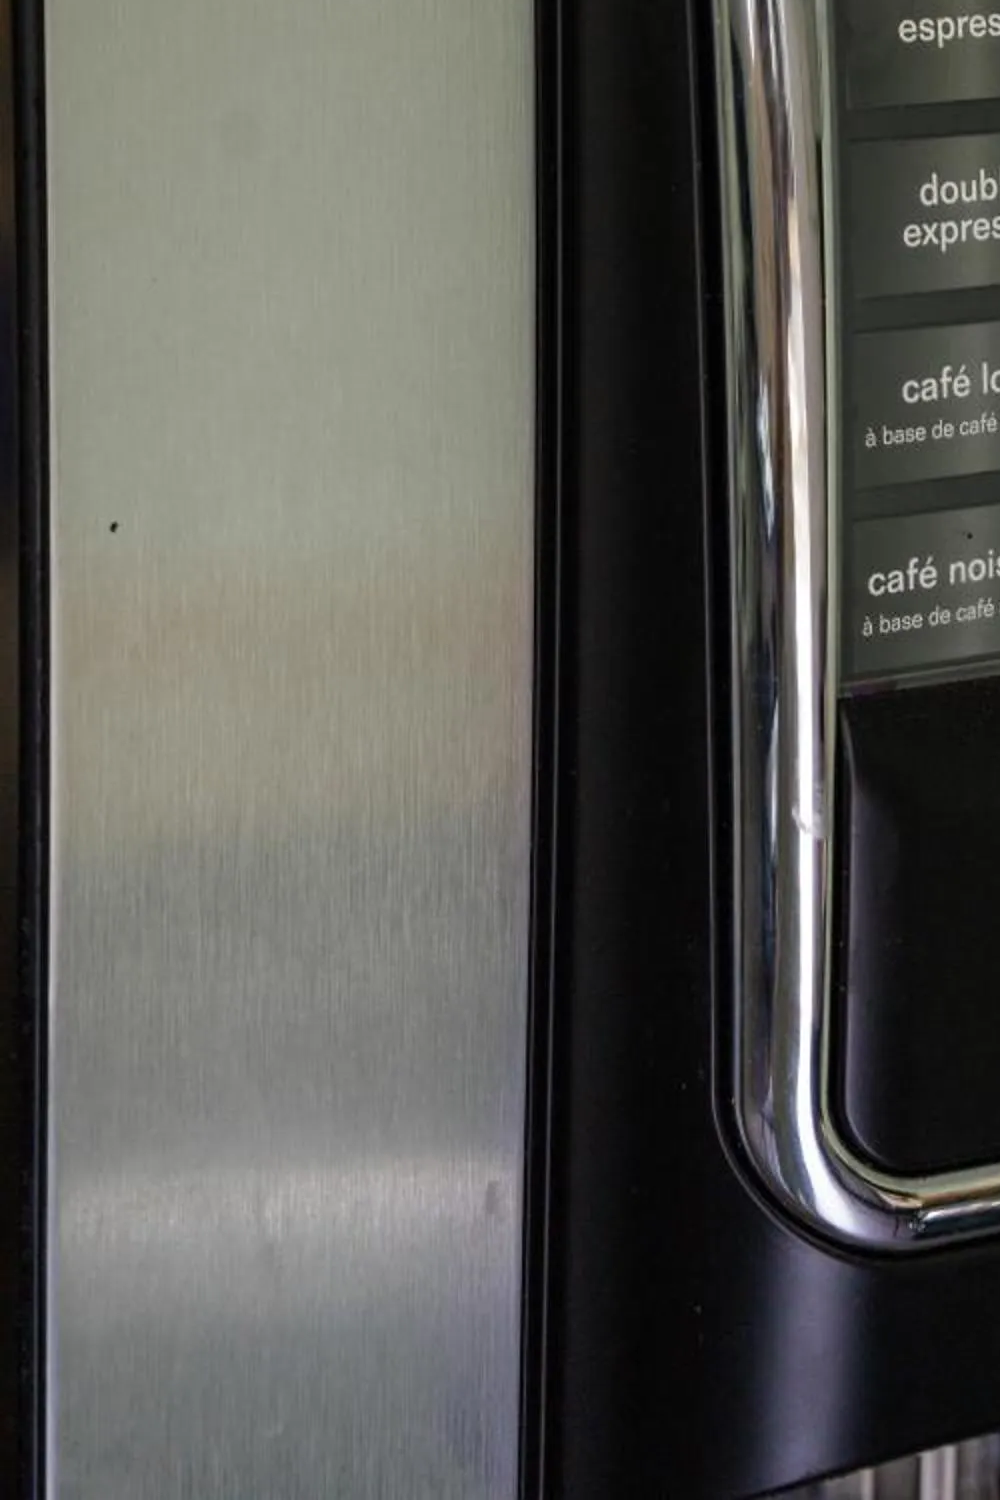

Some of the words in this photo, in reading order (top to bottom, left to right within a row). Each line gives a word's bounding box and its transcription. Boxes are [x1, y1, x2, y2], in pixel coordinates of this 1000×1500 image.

[902, 365, 971, 403] café
[865, 428, 877, 448] à
[882, 425, 926, 445] base
[931, 419, 955, 440] de
[959, 413, 998, 436] café
[867, 556, 938, 597] café
[862, 615, 874, 638] à
[879, 613, 923, 634] base
[928, 607, 952, 627] de
[956, 599, 995, 621] café
